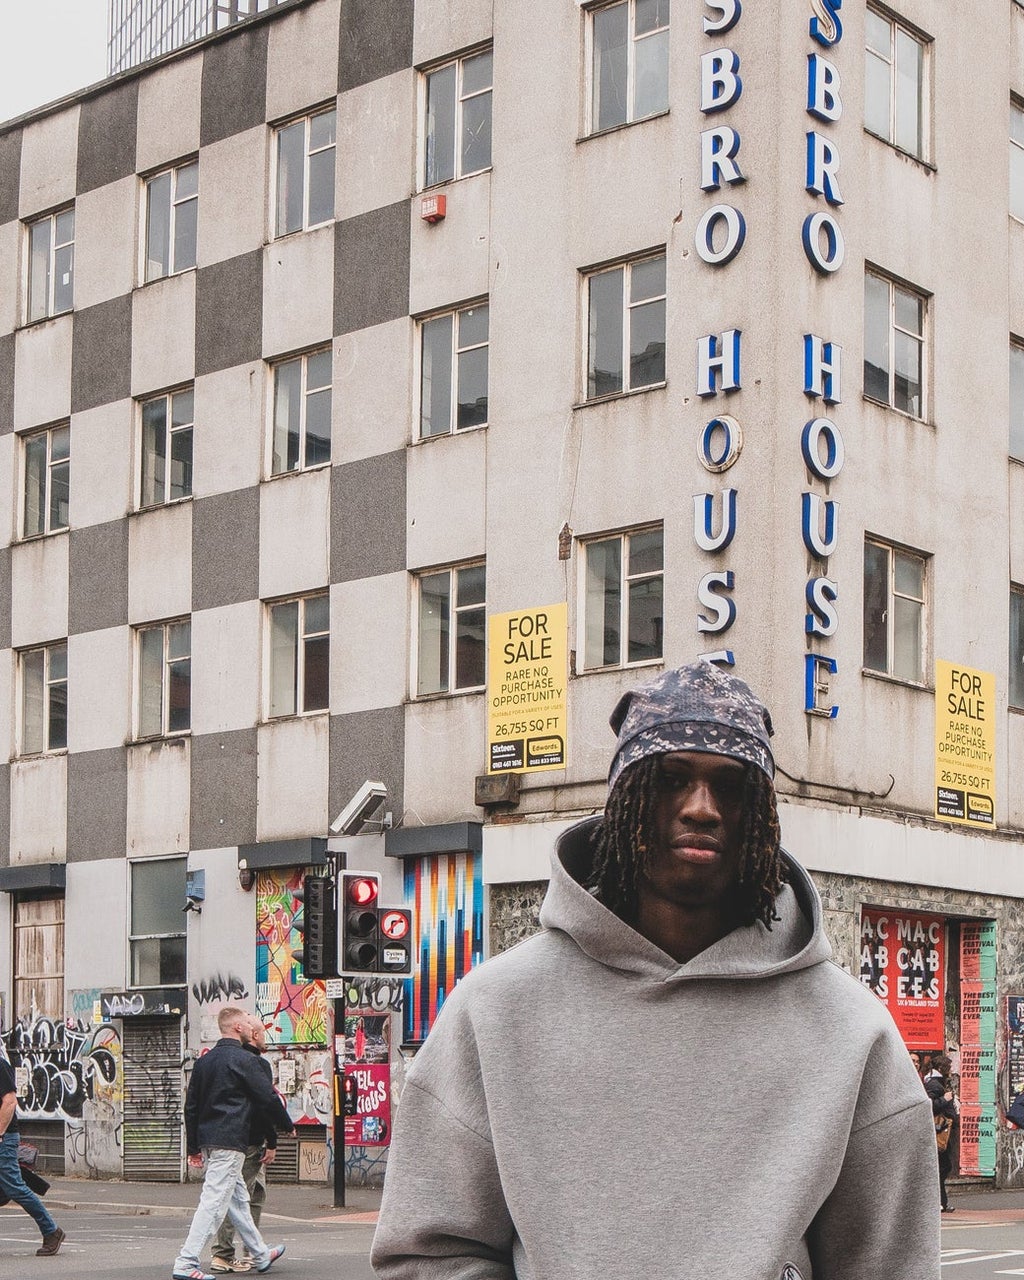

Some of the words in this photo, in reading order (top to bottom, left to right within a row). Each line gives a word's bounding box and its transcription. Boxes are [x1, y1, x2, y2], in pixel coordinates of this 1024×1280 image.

[692, 329, 744, 666] HOUS
[800, 334, 845, 718] HOUSE
[508, 614, 548, 640] FOR
[504, 637, 552, 664] SALE
[502, 678, 553, 694] PURCHASE
[506, 669, 531, 682] RARE
[534, 666, 548, 678] NQ
[952, 670, 982, 697] FOR
[493, 688, 563, 708] OPPORTUNITY
[948, 694, 985, 722] SALE
[496, 721, 528, 736] 26,755
[529, 719, 544, 732] SQ
[546, 717, 559, 729] FT
[950, 720, 969, 735] RARE
[971, 724, 983, 738] NQ
[938, 742, 992, 763] OPPORTUNITY
[946, 732, 986, 750] PURCHASE
[941, 770, 967, 785] 26,755
[968, 776, 980, 788] SQ
[981, 778, 991, 790] FT
[896, 919, 940, 944] MAC
[896, 947, 940, 972] CAB
[897, 976, 939, 1000] EES
